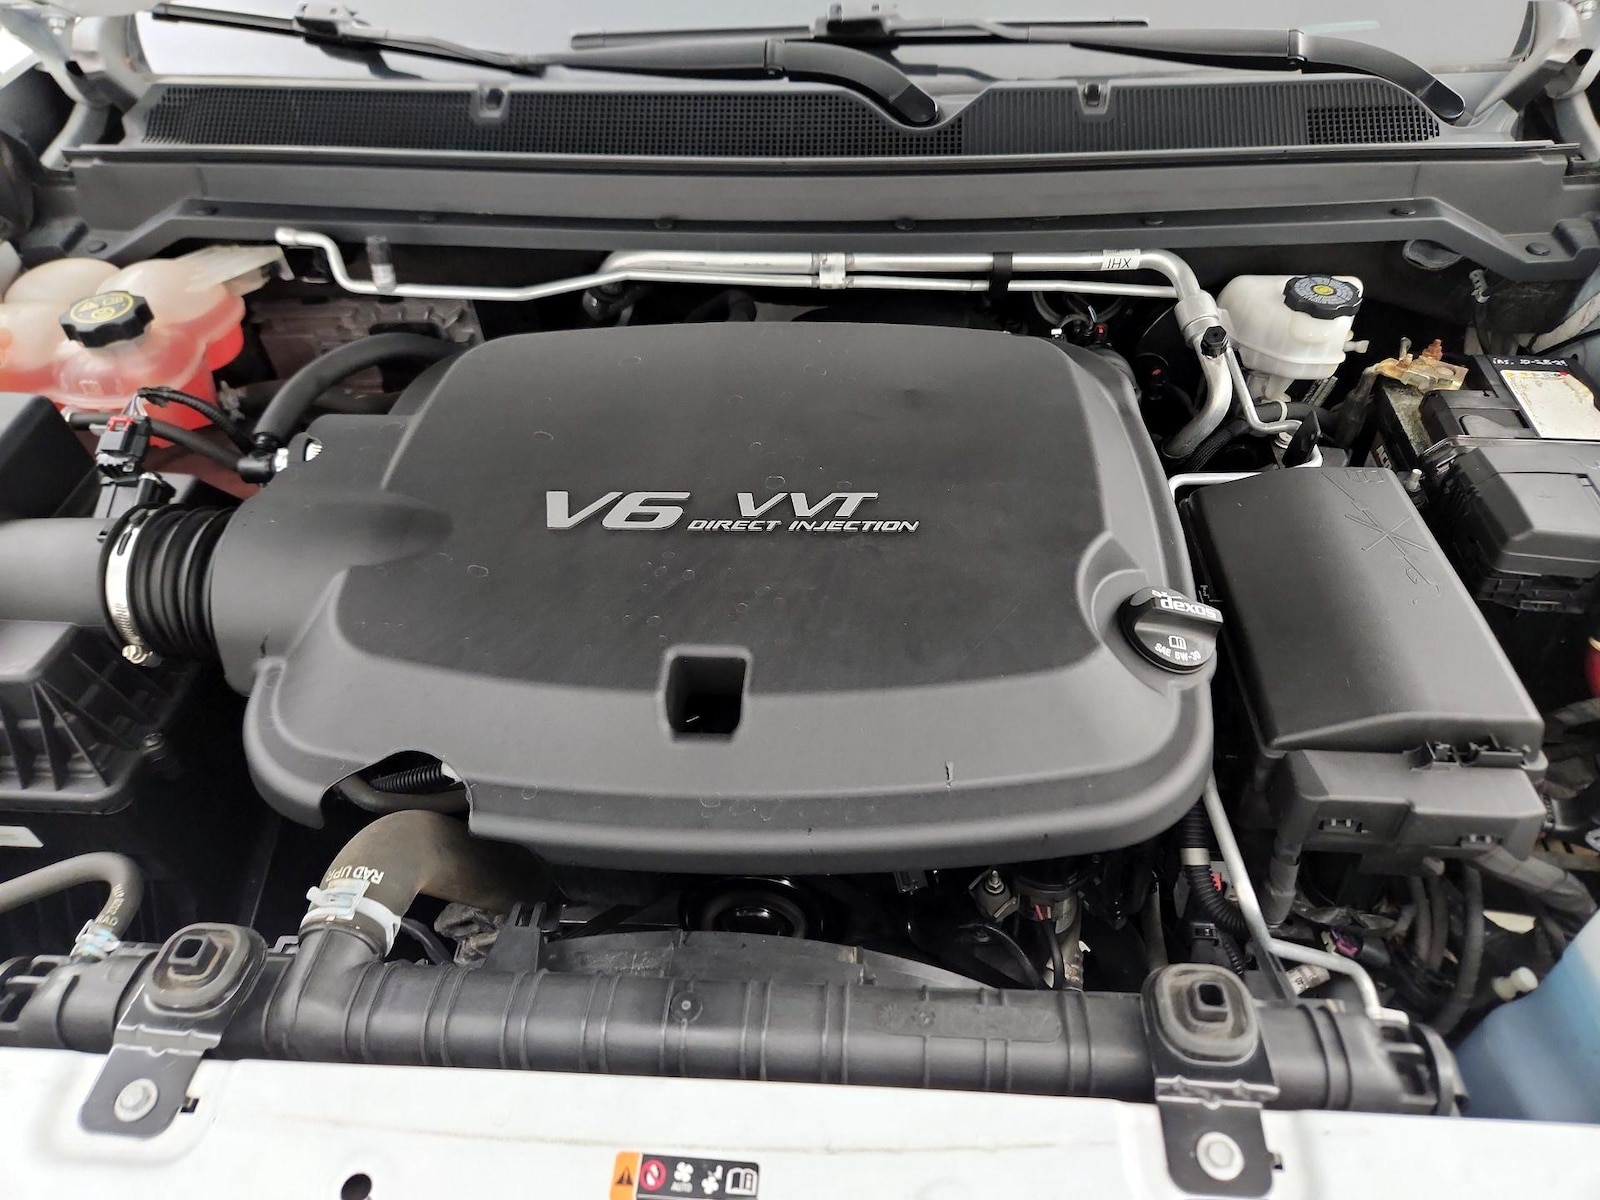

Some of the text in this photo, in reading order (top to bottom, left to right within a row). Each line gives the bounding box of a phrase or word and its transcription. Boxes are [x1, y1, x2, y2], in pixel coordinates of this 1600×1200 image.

[546, 491, 879, 531] V6 VVT
[687, 520, 919, 532] DIRECT INJECTION
[1160, 597, 1217, 619] dexos
[1154, 642, 1202, 662] SAE 5W-30
[352, 865, 385, 885] RAD
